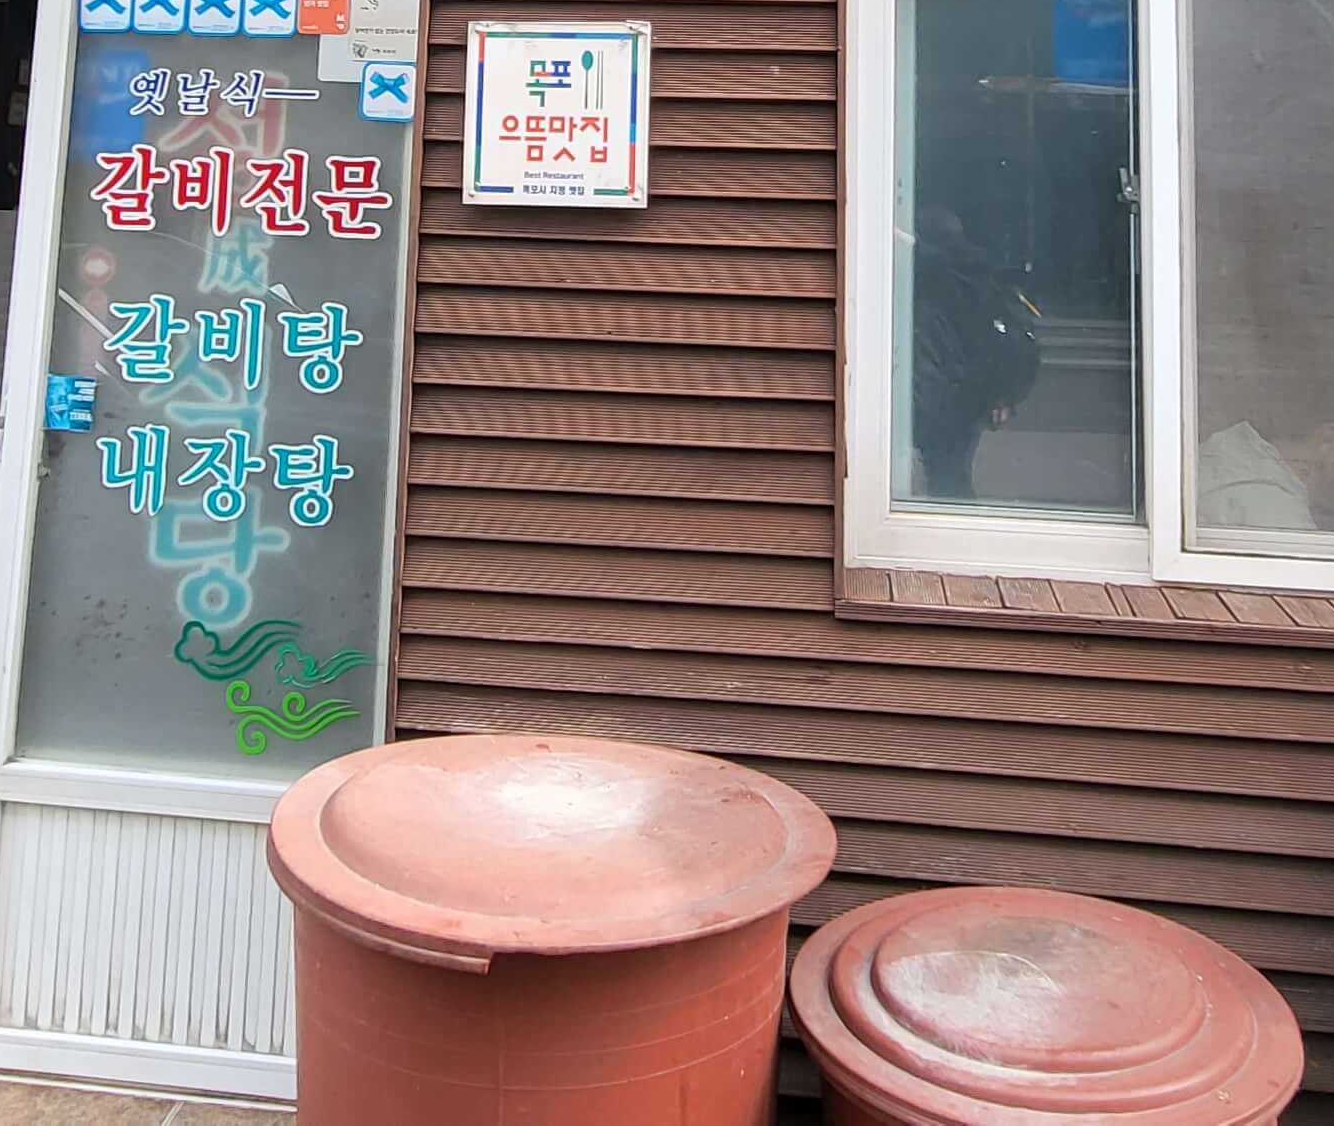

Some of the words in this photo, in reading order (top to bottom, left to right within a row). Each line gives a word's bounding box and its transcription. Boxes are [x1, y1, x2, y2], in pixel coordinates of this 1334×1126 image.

[129, 69, 266, 117] 옛날식
[525, 60, 572, 108] 목포
[499, 114, 609, 163] 으뜸맛집
[91, 145, 393, 239] 갈비전문
[103, 293, 363, 394] 갈비탕
[95, 424, 355, 527] 내장탕
